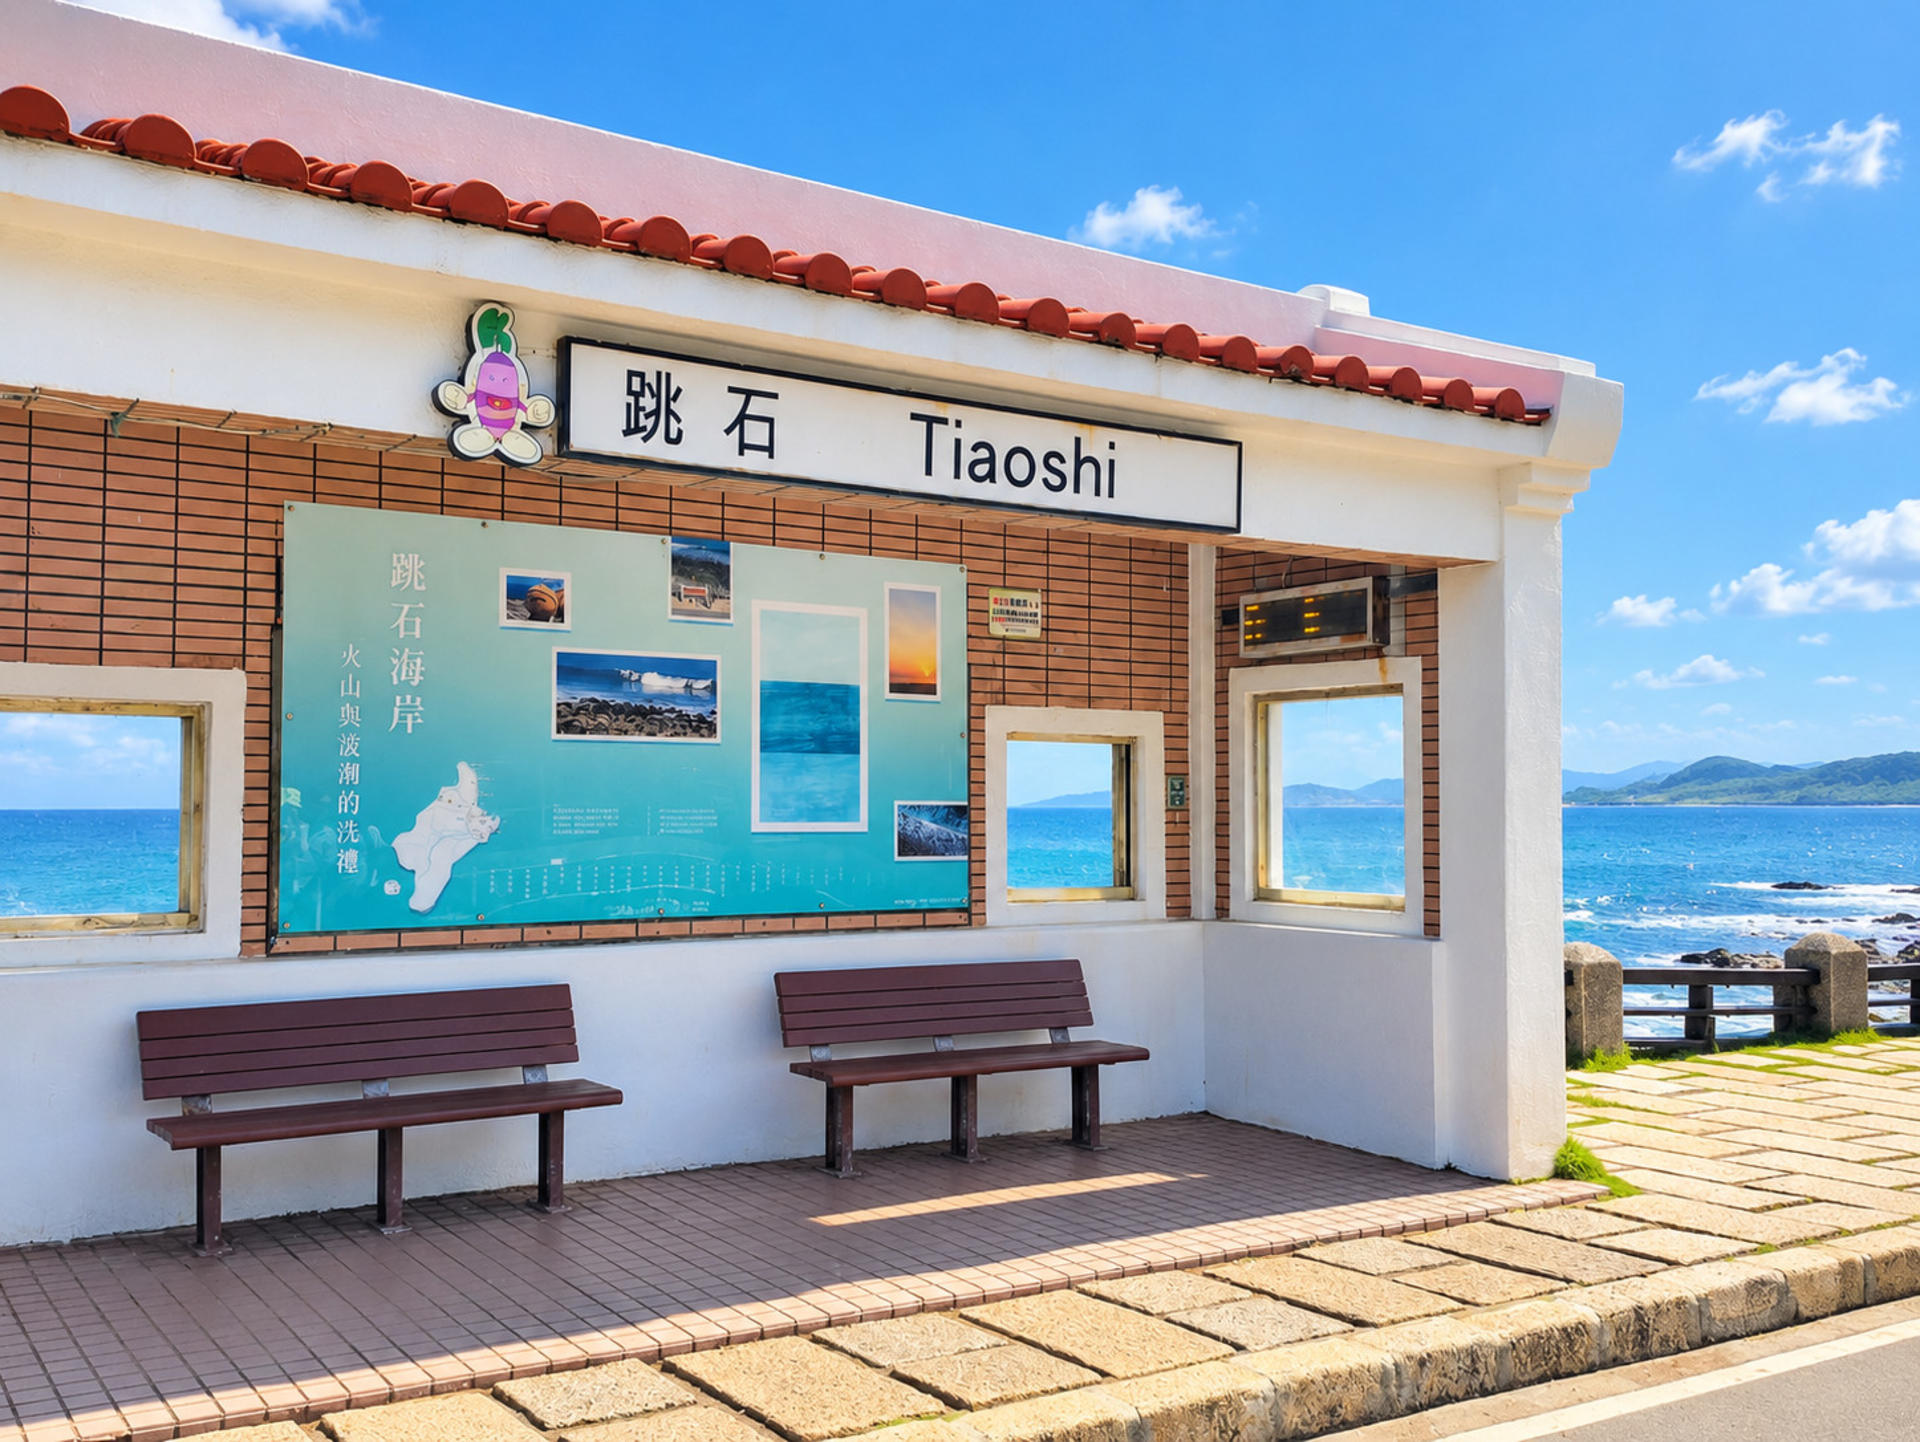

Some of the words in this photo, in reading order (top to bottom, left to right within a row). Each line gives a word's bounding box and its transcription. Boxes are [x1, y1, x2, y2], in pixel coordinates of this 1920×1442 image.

[621, 369, 779, 460] 跳石
[909, 412, 1117, 499] Tiaoshi
[388, 552, 426, 735] 跳石海岸
